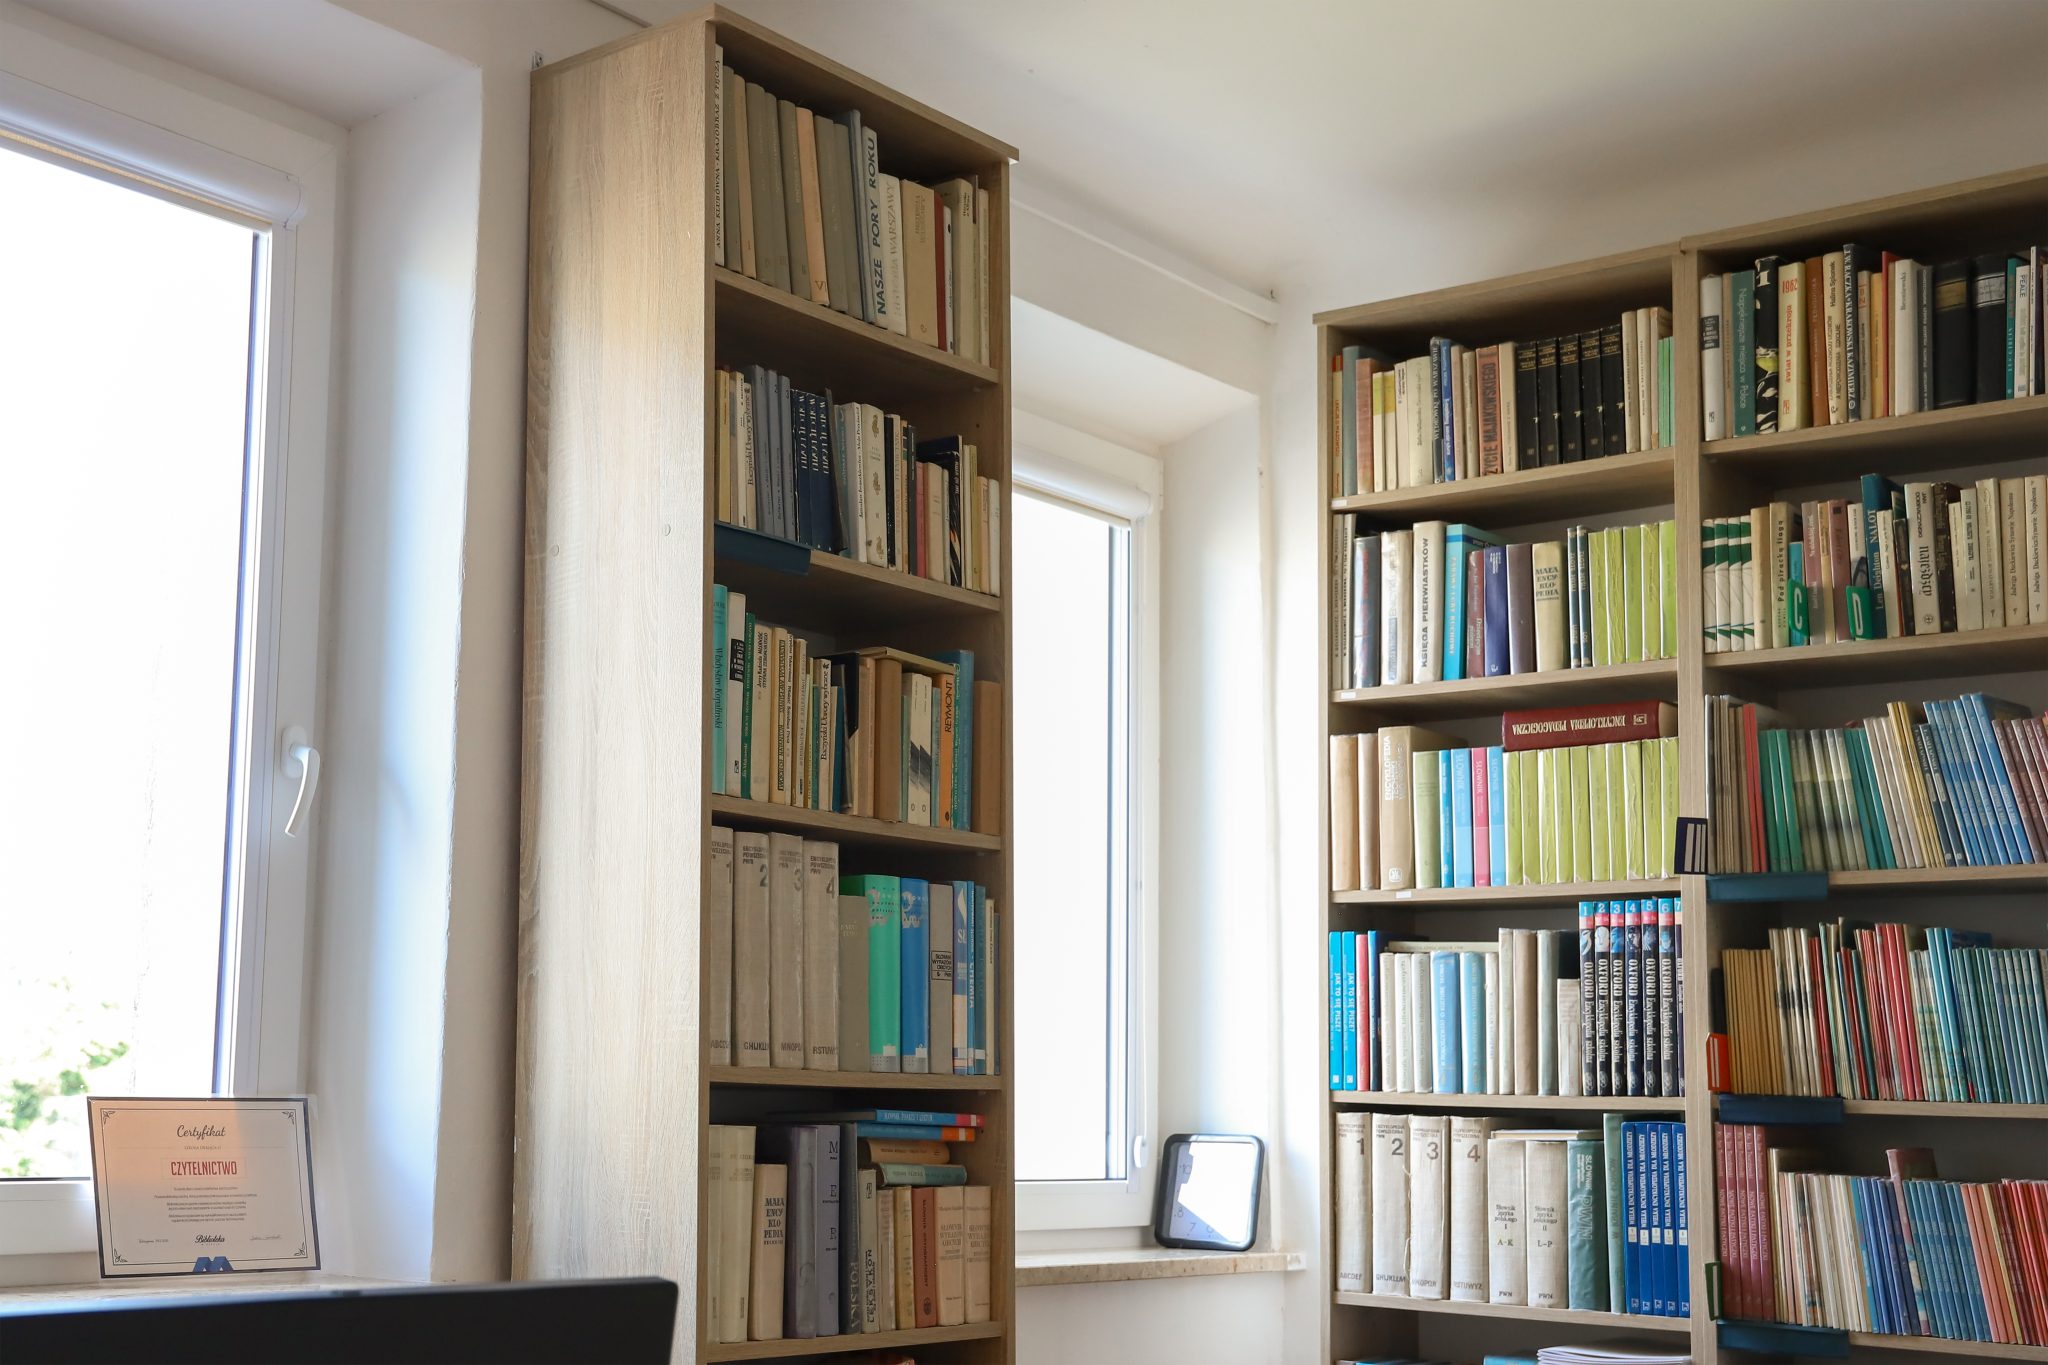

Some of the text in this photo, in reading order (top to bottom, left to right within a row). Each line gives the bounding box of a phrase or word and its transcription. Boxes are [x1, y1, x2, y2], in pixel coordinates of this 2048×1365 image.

[865, 137, 886, 314] NASZE PORY ROKU
[886, 182, 898, 253] WARSZAWY
[1782, 278, 1798, 294] 1962
[1847, 352, 1856, 400] KAZIMIERZ
[1482, 362, 1498, 475] ŻYCIE MAJAKOWSKIEGO
[1868, 509, 1884, 608] Len Deighton NALOT
[1421, 626, 1429, 668] KSIĘGA
[714, 688, 723, 728] Kopaliński
[944, 678, 953, 734] REYMONT
[1512, 715, 1626, 736] ENCYKLOPEDIA PEDAGOGICZNA
[820, 727, 829, 760] Baczyński
[1384, 736, 1392, 800] ENCYKLOPEDIA
[1475, 760, 1483, 794] SŁOWNIK
[760, 864, 768, 888] 2
[794, 868, 802, 892] 3
[826, 877, 836, 899] 4
[1583, 905, 1588, 916] 1
[1598, 902, 1606, 912] 2
[1613, 903, 1621, 914] 3
[1628, 902, 1636, 912] 4
[1646, 899, 1653, 910] 5
[1662, 902, 1670, 912] 6
[1675, 900, 1681, 910] 7
[1582, 962, 1594, 1064] OXFORD Encyklopedia szkolna
[1597, 958, 1608, 1062] OXFORD Encyklopedia szkolna
[1612, 960, 1622, 1063] OXFORD Encyklopedia szkolna
[1626, 959, 1638, 1062] OXFORD Encyklopedia szkolna
[1644, 958, 1656, 1060] OXFORD Encyklopedia szkolna
[1660, 958, 1673, 1060] OXFORD Encyklopedia szkolna
[176, 1124, 226, 1140] Certyfikat
[828, 1141, 838, 1154] M
[1356, 1138, 1365, 1156] 1
[1391, 1138, 1404, 1156] 2
[1426, 1142, 1439, 1160] 3
[1467, 1144, 1480, 1162] 4
[170, 1160, 238, 1176] CZYTELNICTWO
[1584, 1154, 1592, 1190] SŁOWNIK
[765, 1198, 784, 1206] MAŁA
[194, 1234, 225, 1244] Biblioteka
[764, 1229, 784, 1238] PEDIA
[866, 1250, 875, 1324] LEKSYKON
[1340, 1272, 1362, 1281] ABCDEF
[850, 1262, 860, 1328] POLSKA
